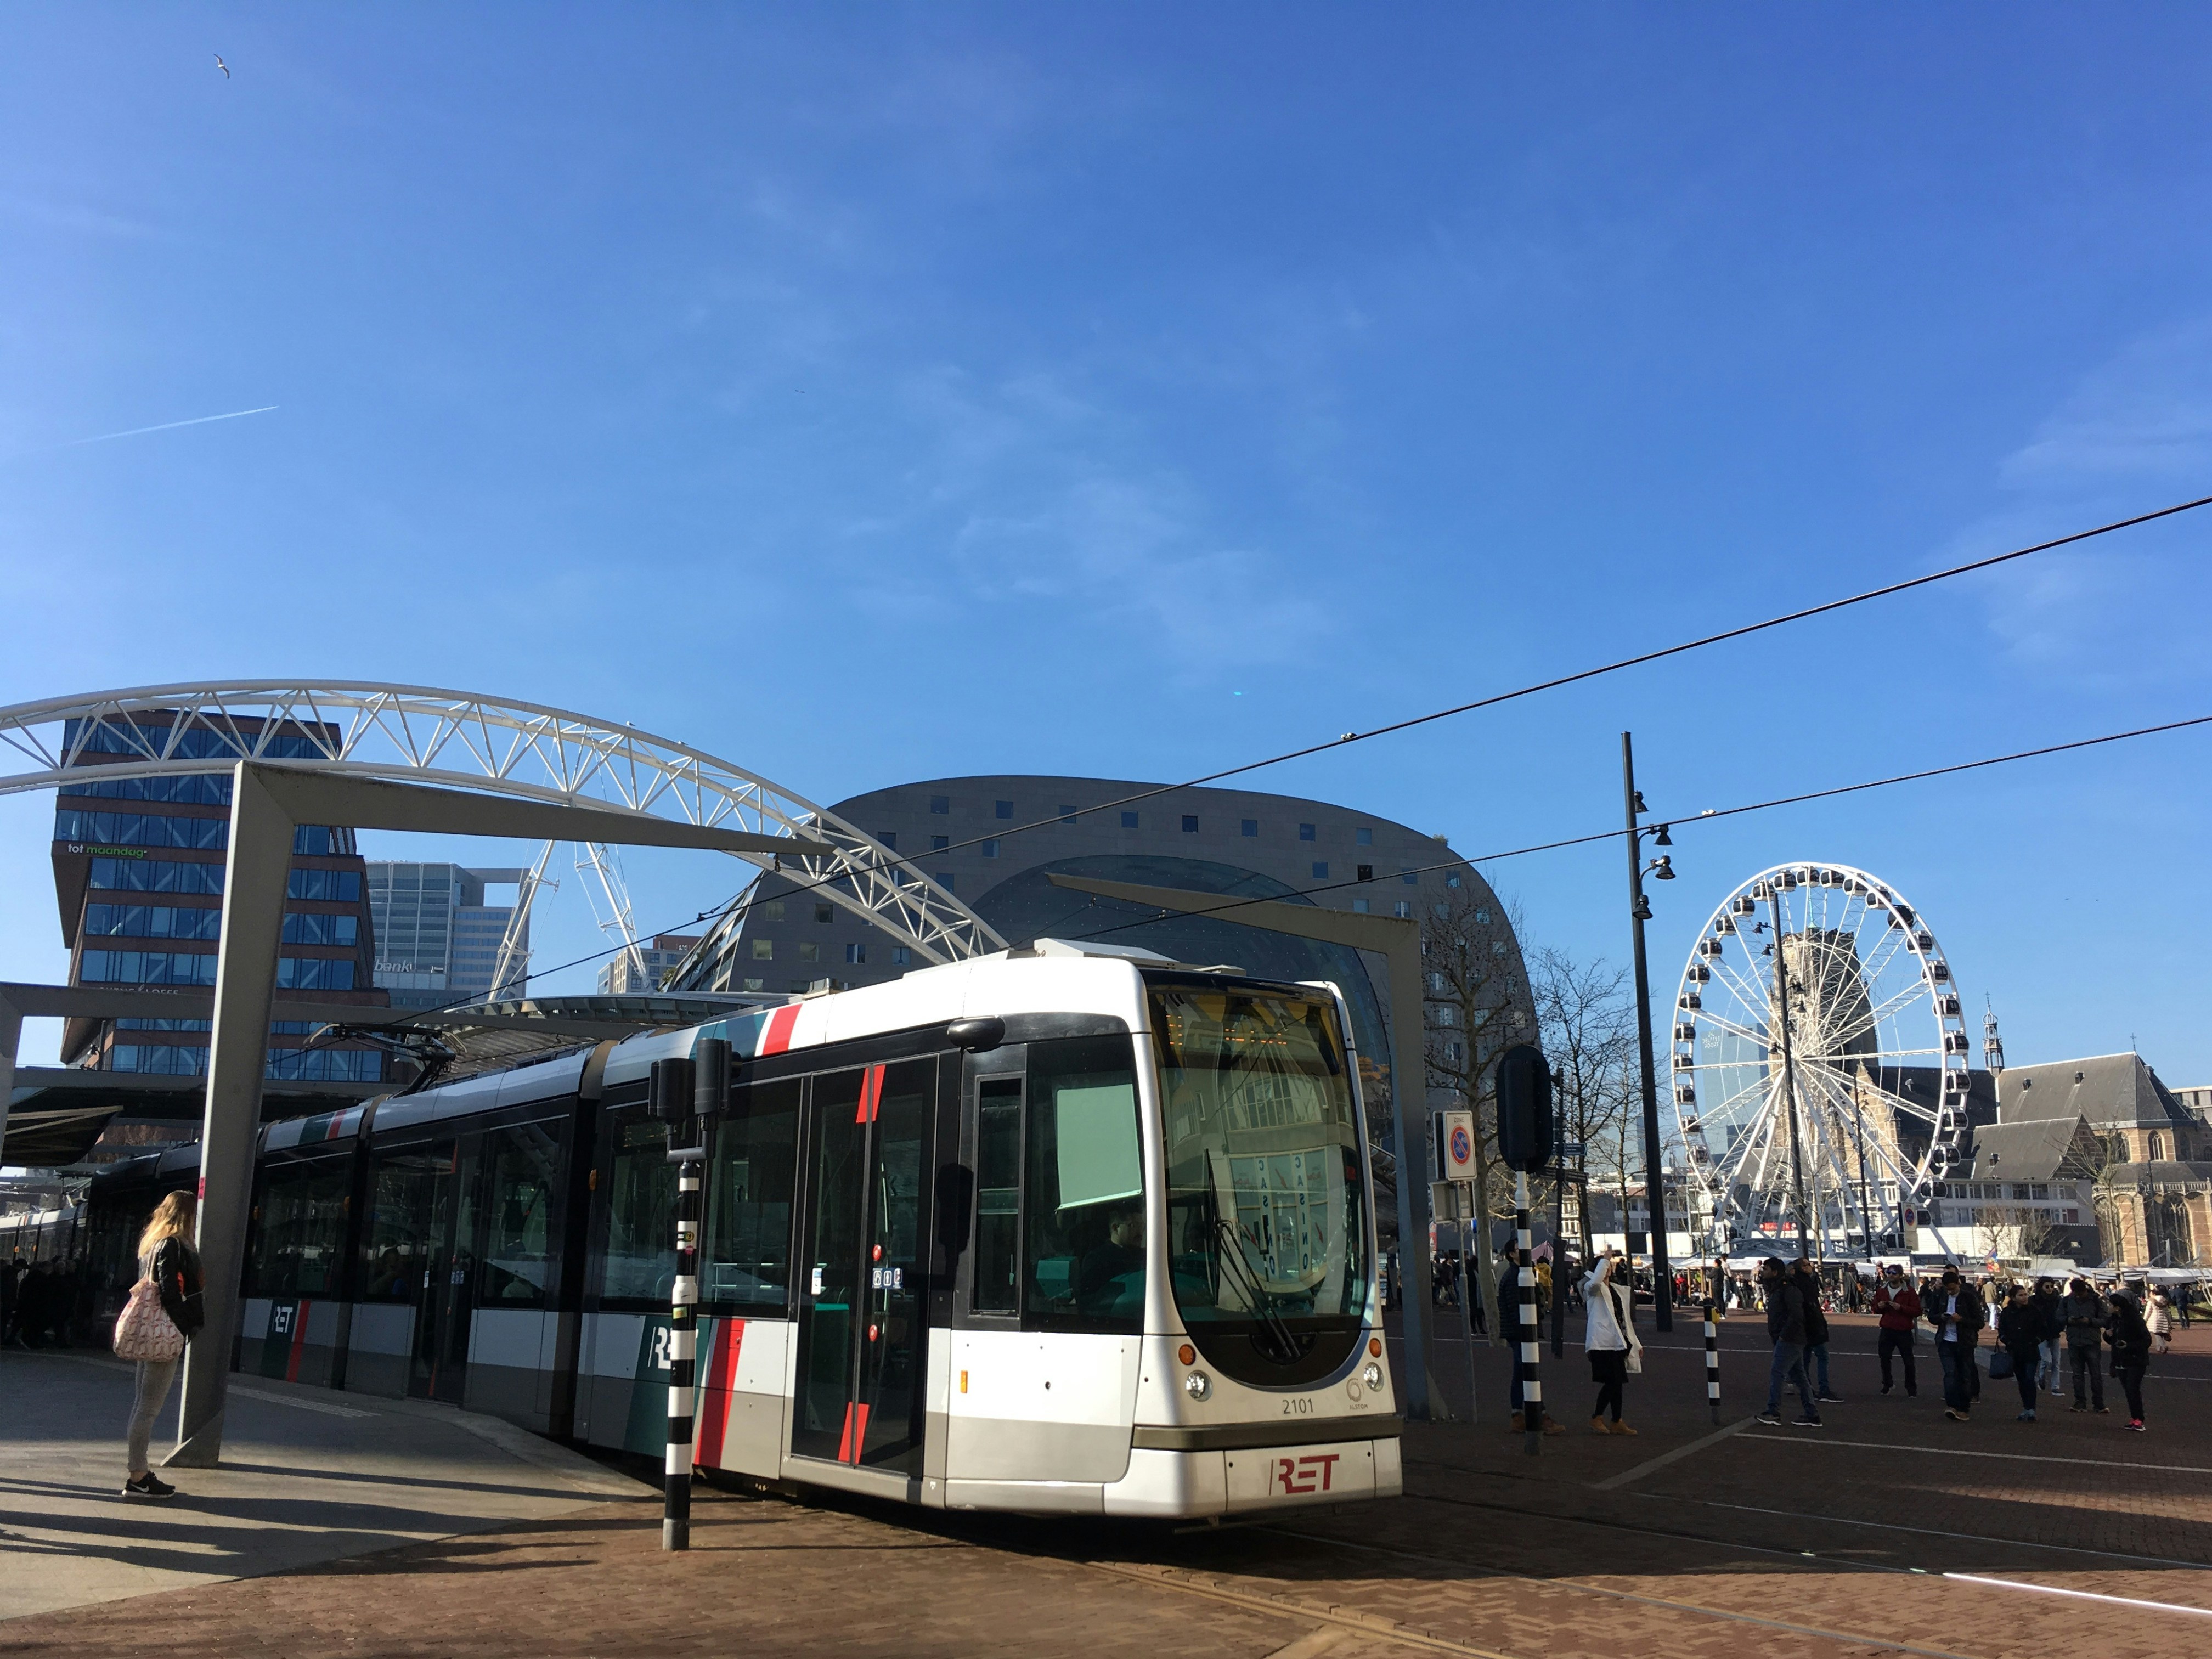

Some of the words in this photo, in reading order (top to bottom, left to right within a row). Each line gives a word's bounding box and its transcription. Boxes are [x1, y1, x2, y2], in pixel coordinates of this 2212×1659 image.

[68, 844, 84, 853] tot
[374, 958, 410, 972] bank
[1282, 1398, 1313, 1414] 2101
[1269, 1454, 1340, 1496] RET
